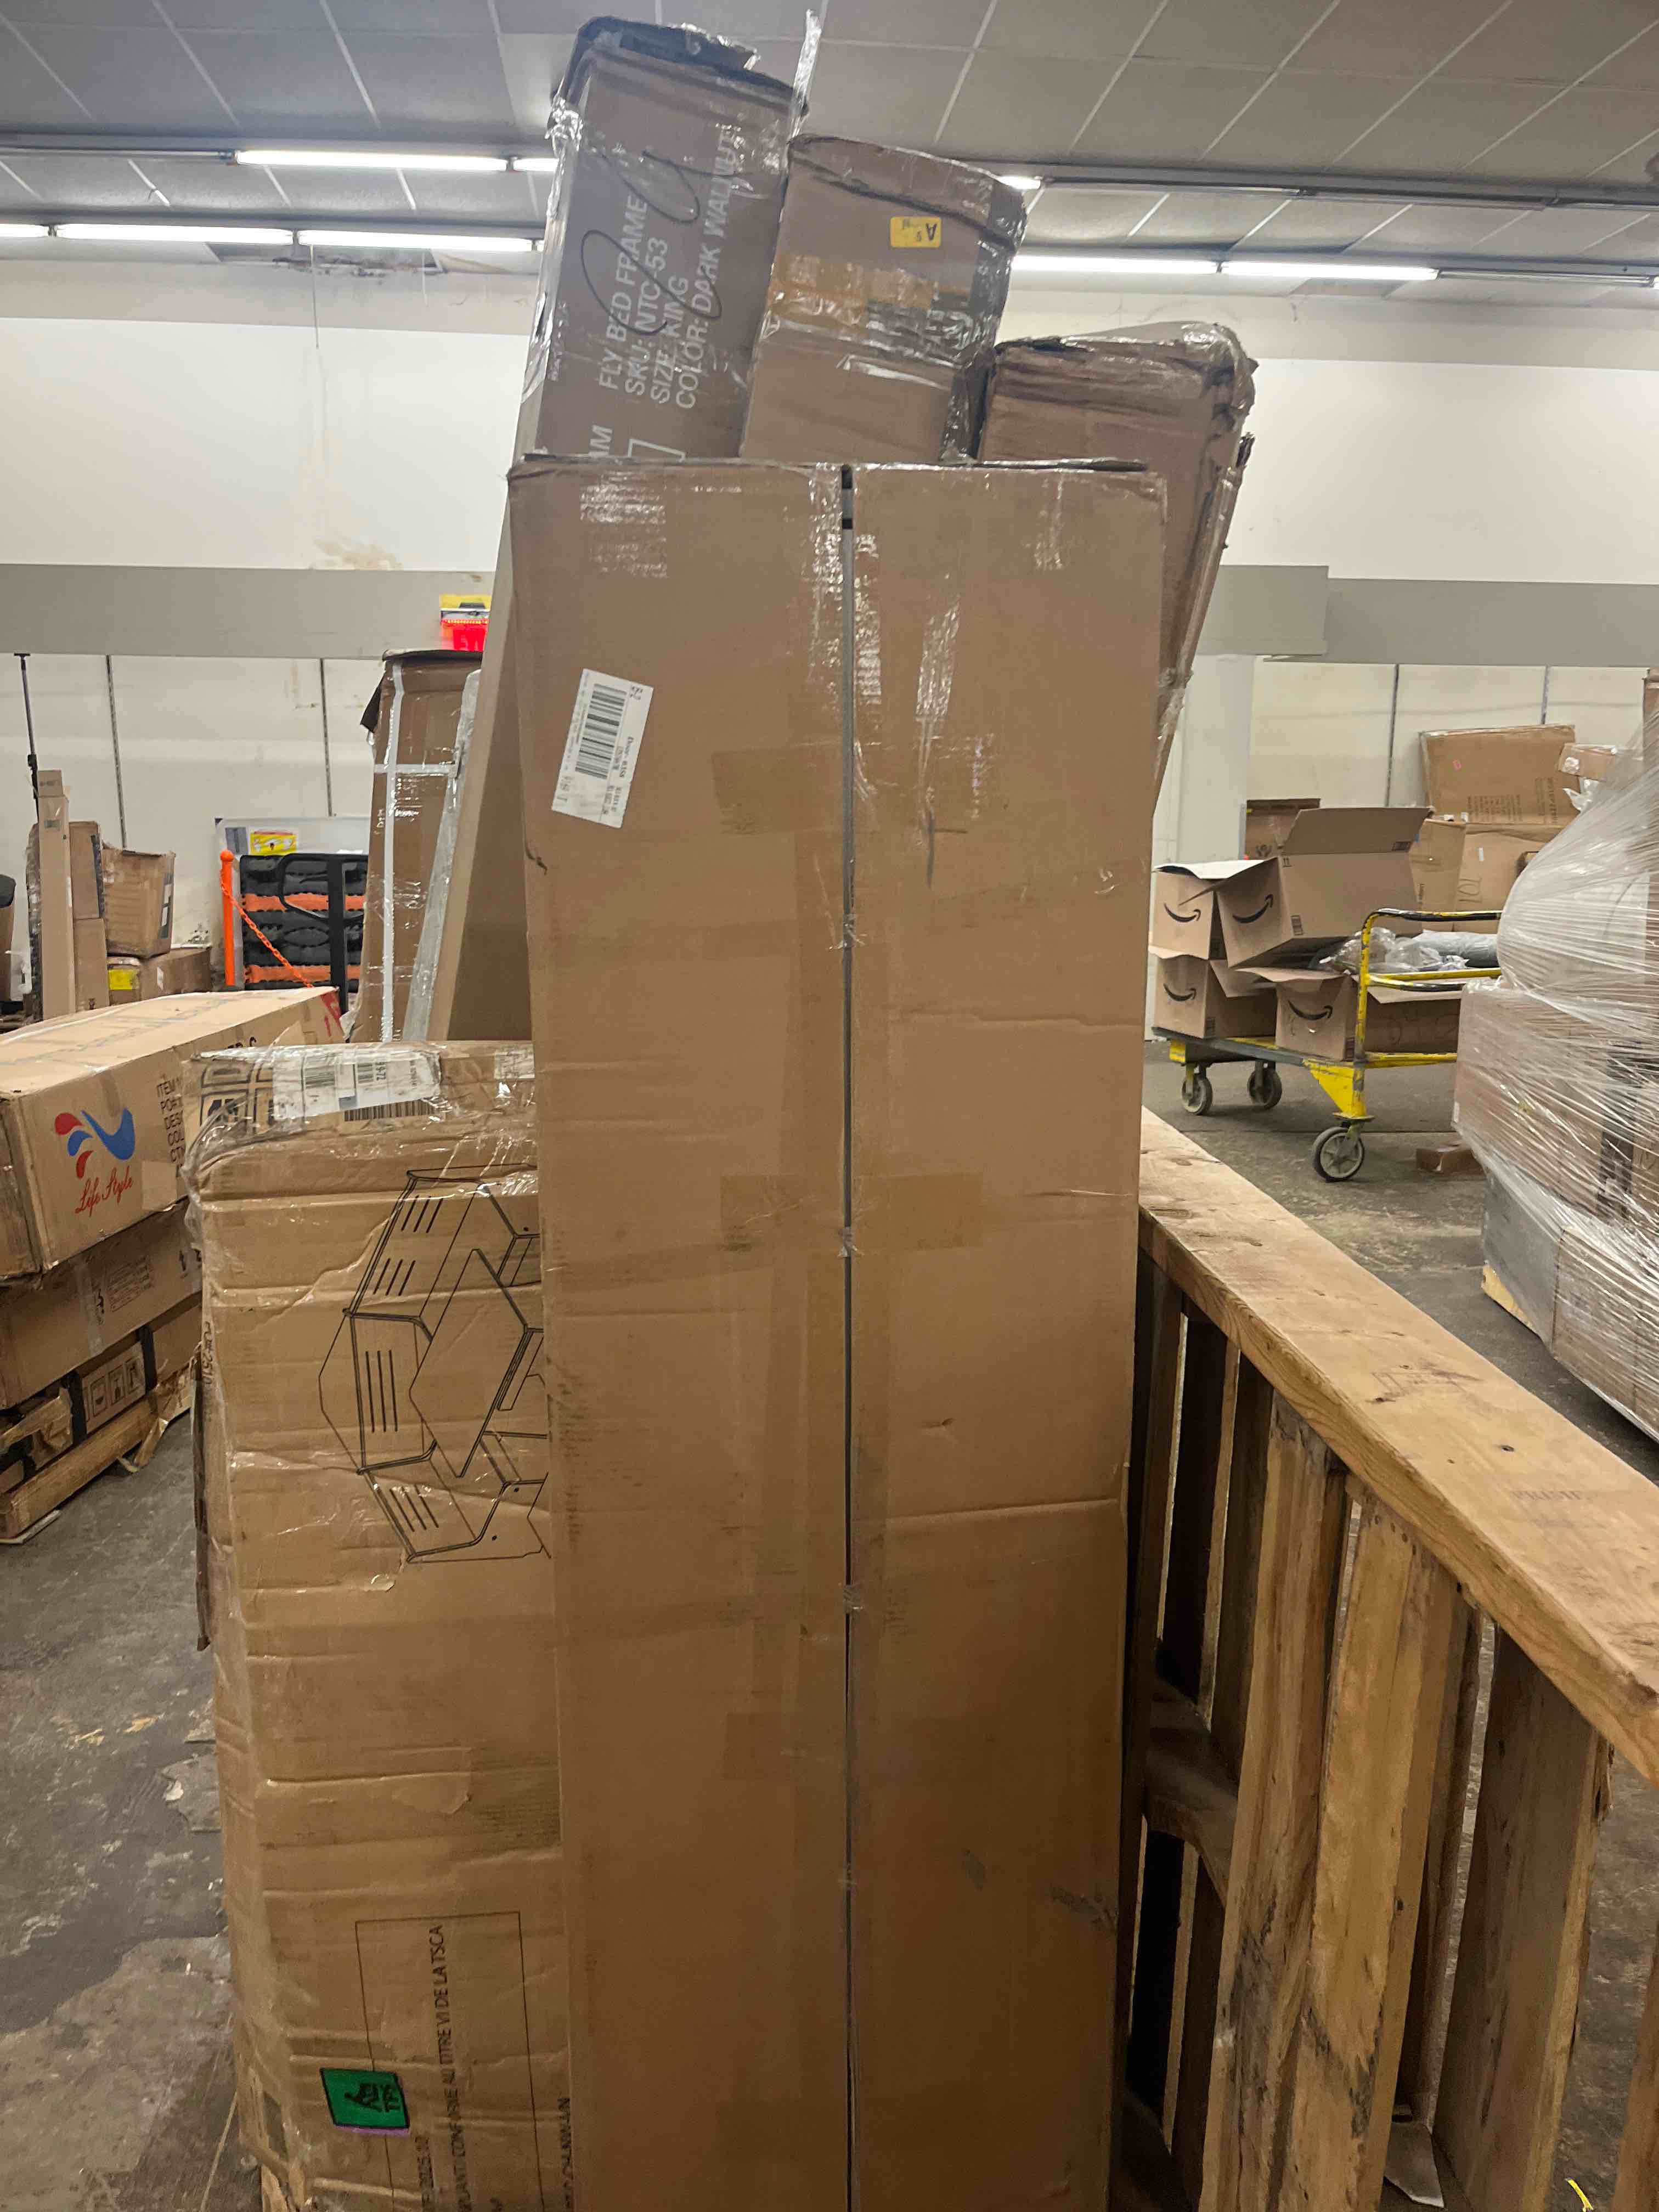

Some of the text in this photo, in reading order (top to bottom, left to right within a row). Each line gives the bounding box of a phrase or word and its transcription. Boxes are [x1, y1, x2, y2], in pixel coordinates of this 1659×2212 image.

[676, 125, 736, 409] COLOR: DARK WALNUT
[599, 195, 648, 390] FLY BED FRAME
[624, 238, 668, 396] SKU: NTC-53
[651, 276, 689, 404] SIZE: KING
[74, 1165, 133, 1217] Life Style
[429, 1925, 445, 1964] TSCA
[432, 1966, 447, 1984] LA
[434, 1988, 449, 2008] DE
[436, 2012, 450, 2028] VI
[438, 2028, 453, 2064] TITRE
